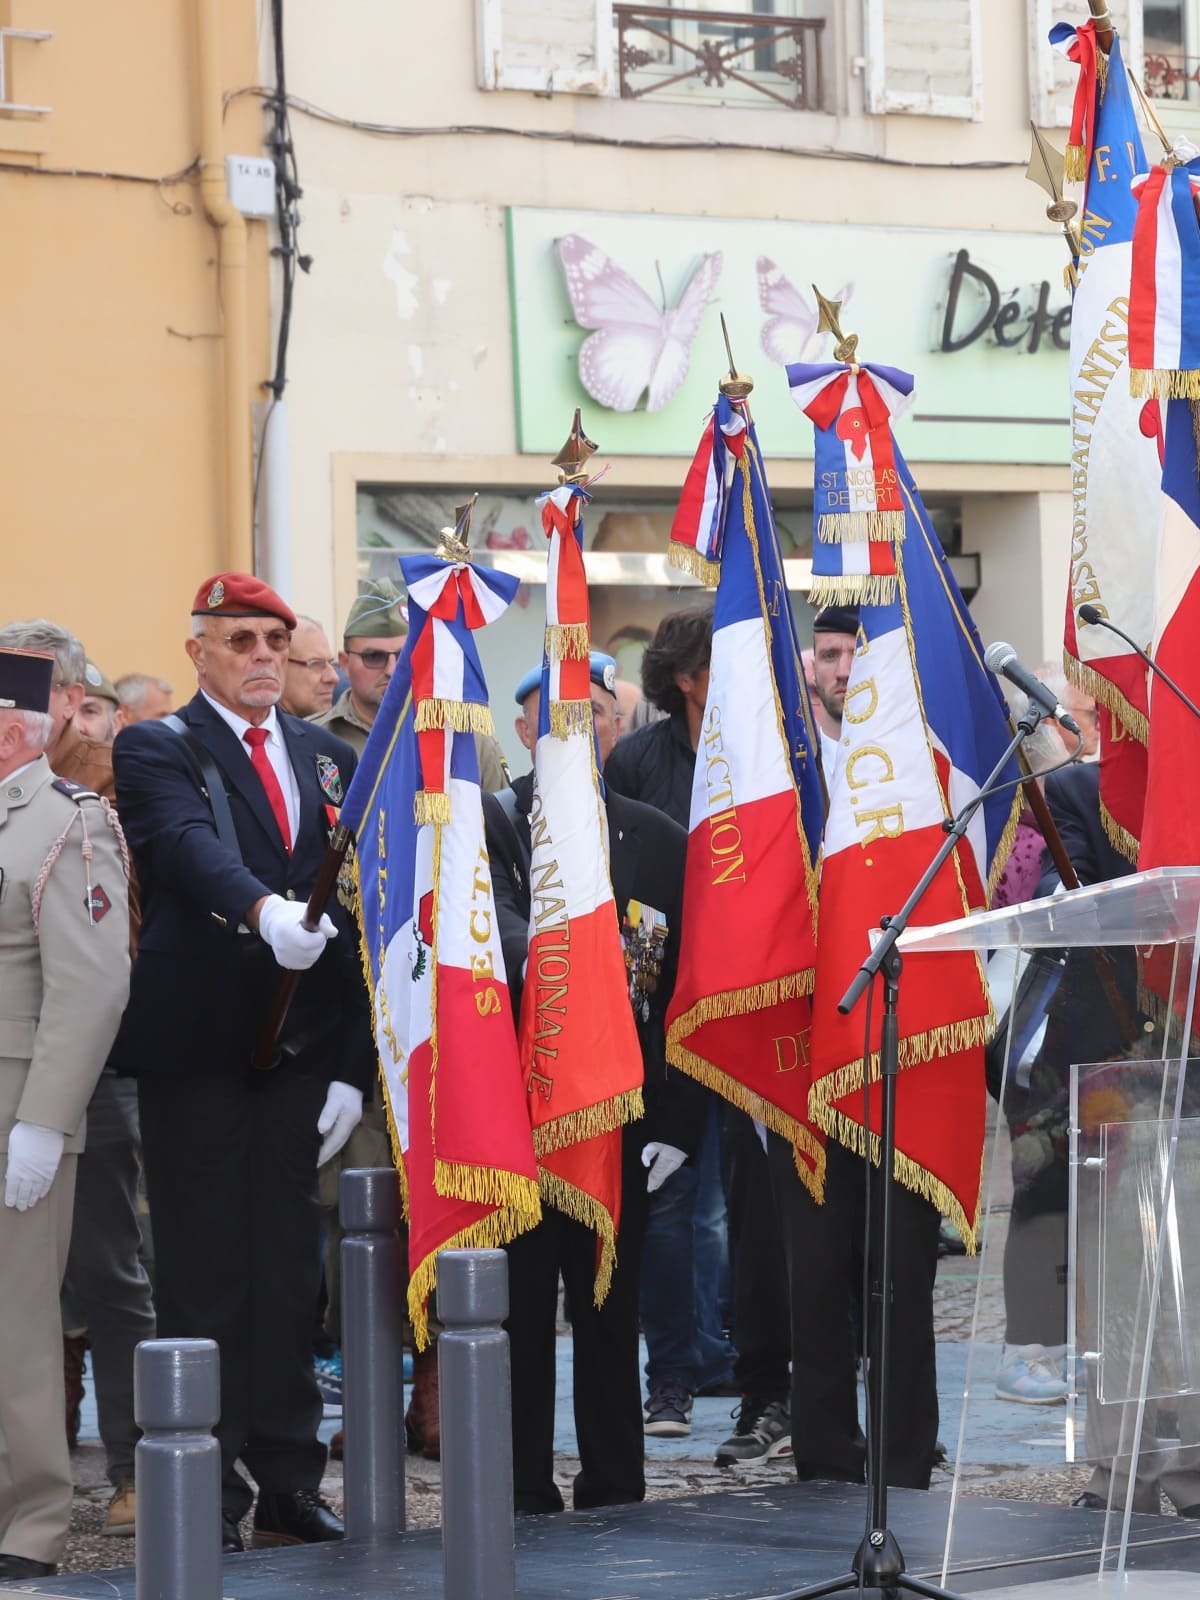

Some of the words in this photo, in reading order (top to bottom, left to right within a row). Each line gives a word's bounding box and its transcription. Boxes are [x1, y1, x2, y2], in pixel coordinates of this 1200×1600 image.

[942, 249, 1071, 353] Déte
[821, 471, 838, 489] ST
[844, 468, 897, 487] NICOLAS
[827, 490, 850, 507] DE
[855, 487, 894, 505] PORT
[702, 704, 748, 887] SECTION
[469, 841, 502, 1018] SECT
[526, 858, 572, 1103] NATIONALE
